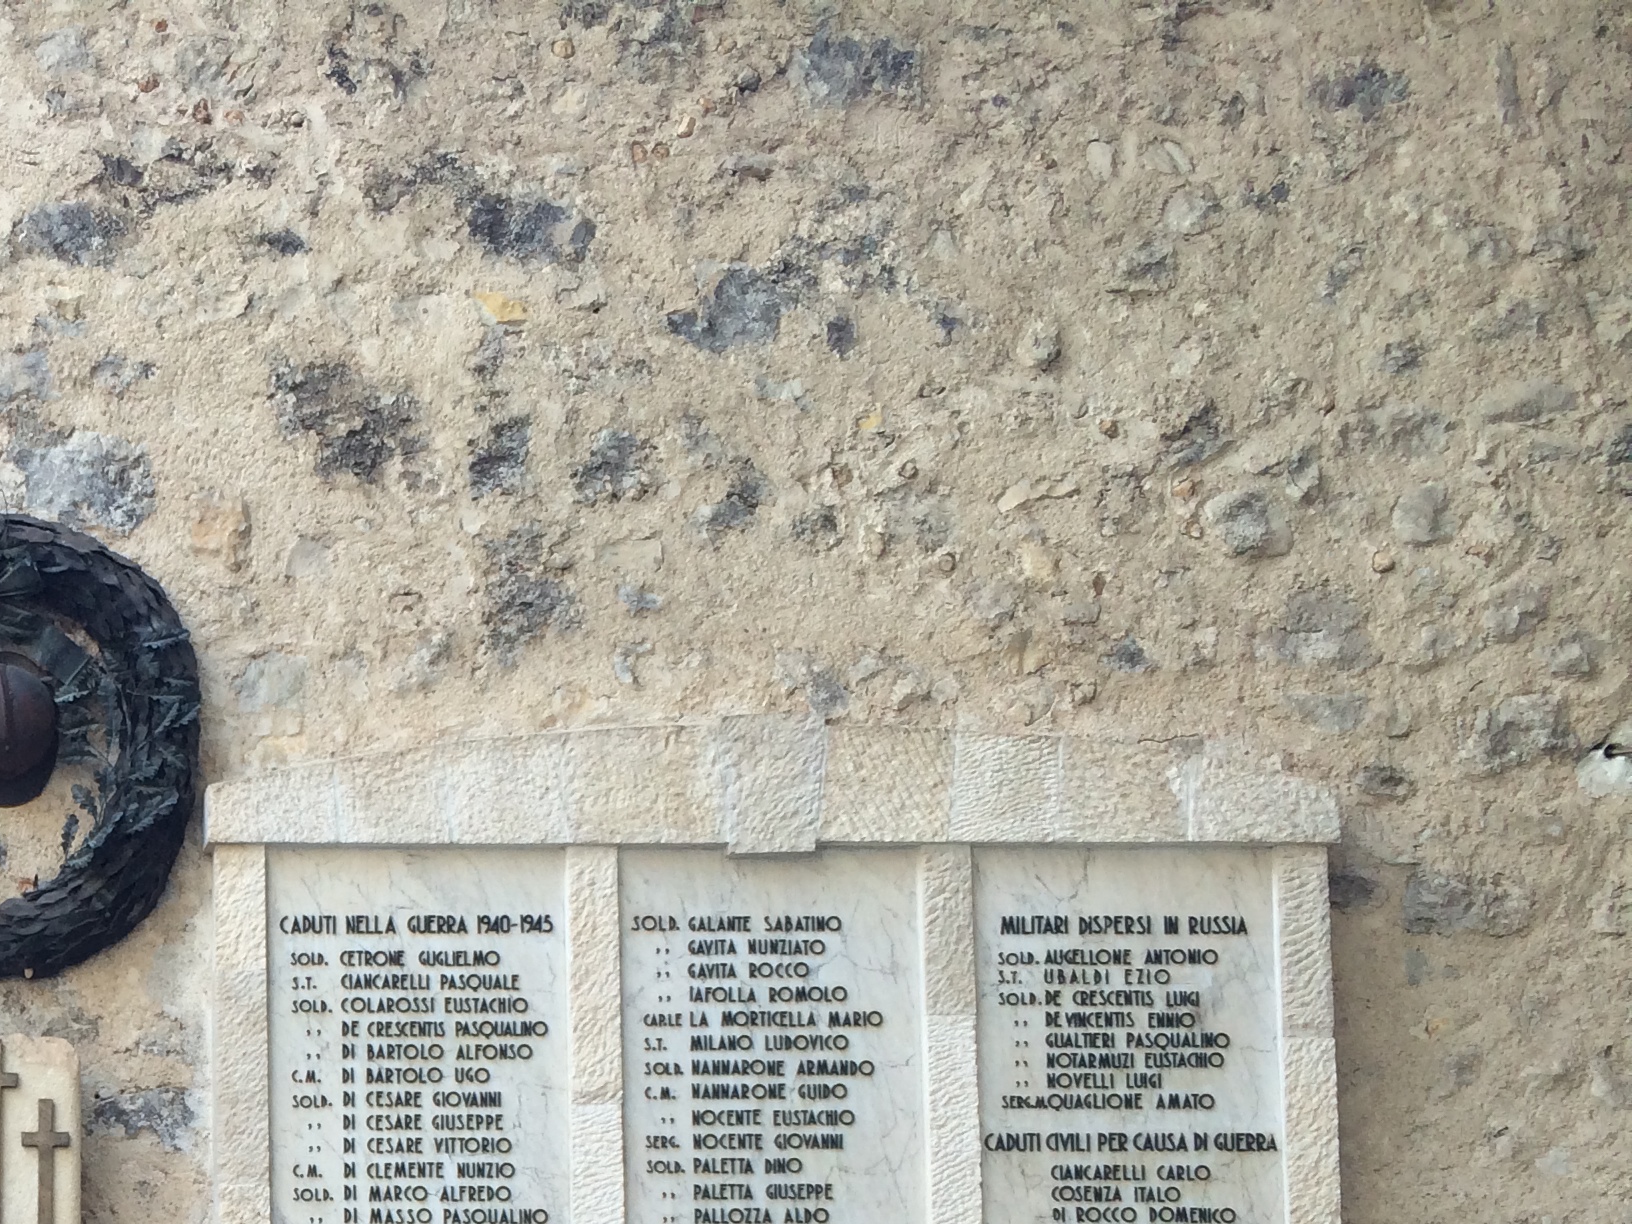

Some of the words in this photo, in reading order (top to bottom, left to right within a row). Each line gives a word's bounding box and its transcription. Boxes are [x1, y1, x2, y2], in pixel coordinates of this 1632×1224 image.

[280, 915, 336, 935] CADUTI
[346, 915, 396, 934] NELLA
[407, 915, 468, 934] GUERRA
[477, 915, 553, 934] 1940-1945
[631, 916, 680, 933] SOLD.
[688, 916, 751, 932] GALANTE
[764, 916, 842, 933] SABATINO
[1001, 916, 1068, 935] MILITARI
[1079, 916, 1151, 935] DISPERSI
[1164, 916, 1178, 935] IN
[1189, 916, 1248, 936] RUSSIA
[291, 952, 328, 966] SOLD.
[340, 950, 405, 968] CETRONE
[419, 950, 500, 967] GUGLIELMO
[998, 952, 1040, 966] SOLD.
[1044, 949, 1131, 966] AUGELLONE
[1144, 949, 1218, 965] ANTONIO
[998, 970, 1022, 985] S.T.
[1044, 969, 1109, 985] UBALDI
[1125, 969, 1170, 985] EZIO
[292, 1000, 332, 1013] SOLD.
[341, 997, 434, 1013] COLAROSSI
[445, 997, 529, 1013] EUSTACHIO
[645, 1038, 667, 1051] S.T.
[690, 1035, 753, 1051] MILANO
[765, 1035, 849, 1051] LUDOVICO
[292, 1070, 321, 1083] C.M.
[342, 1068, 354, 1084] DI
[367, 1067, 443, 1084] BARTOLO
[455, 1067, 490, 1084] UGO
[293, 1095, 332, 1108] SOLD.
[343, 1091, 355, 1107] DI
[366, 1091, 422, 1108] CESARE
[433, 1092, 501, 1107] GIOVANNI
[646, 1135, 680, 1149] SERG.
[693, 1134, 763, 1150] NOCENTE
[774, 1133, 844, 1150] GIOVANNI
[983, 1133, 1041, 1152] CADUTI
[1046, 1133, 1090, 1152] CIVILI
[1098, 1133, 1128, 1152] PER
[1133, 1133, 1188, 1152] CAUSA
[1194, 1132, 1208, 1151] DI
[1214, 1133, 1278, 1152] GUERRA
[647, 1160, 685, 1174] SOLD.
[693, 1158, 754, 1174] PALETTA
[765, 1158, 802, 1174] DINO
[1051, 1165, 1145, 1181] CIANCARELLI
[1157, 1165, 1211, 1181] CARLO
[293, 1188, 333, 1202] SOLD.
[344, 1185, 357, 1201] DI
[369, 1185, 429, 1202] MARCO
[440, 1186, 511, 1202] ALFREDO
[1051, 1186, 1122, 1202] COSENZA
[1135, 1187, 1181, 1203] ITALO
[1052, 1207, 1065, 1222] DI
[1076, 1207, 1137, 1223] ROCCO
[1150, 1207, 1236, 1224] DOMENICO
